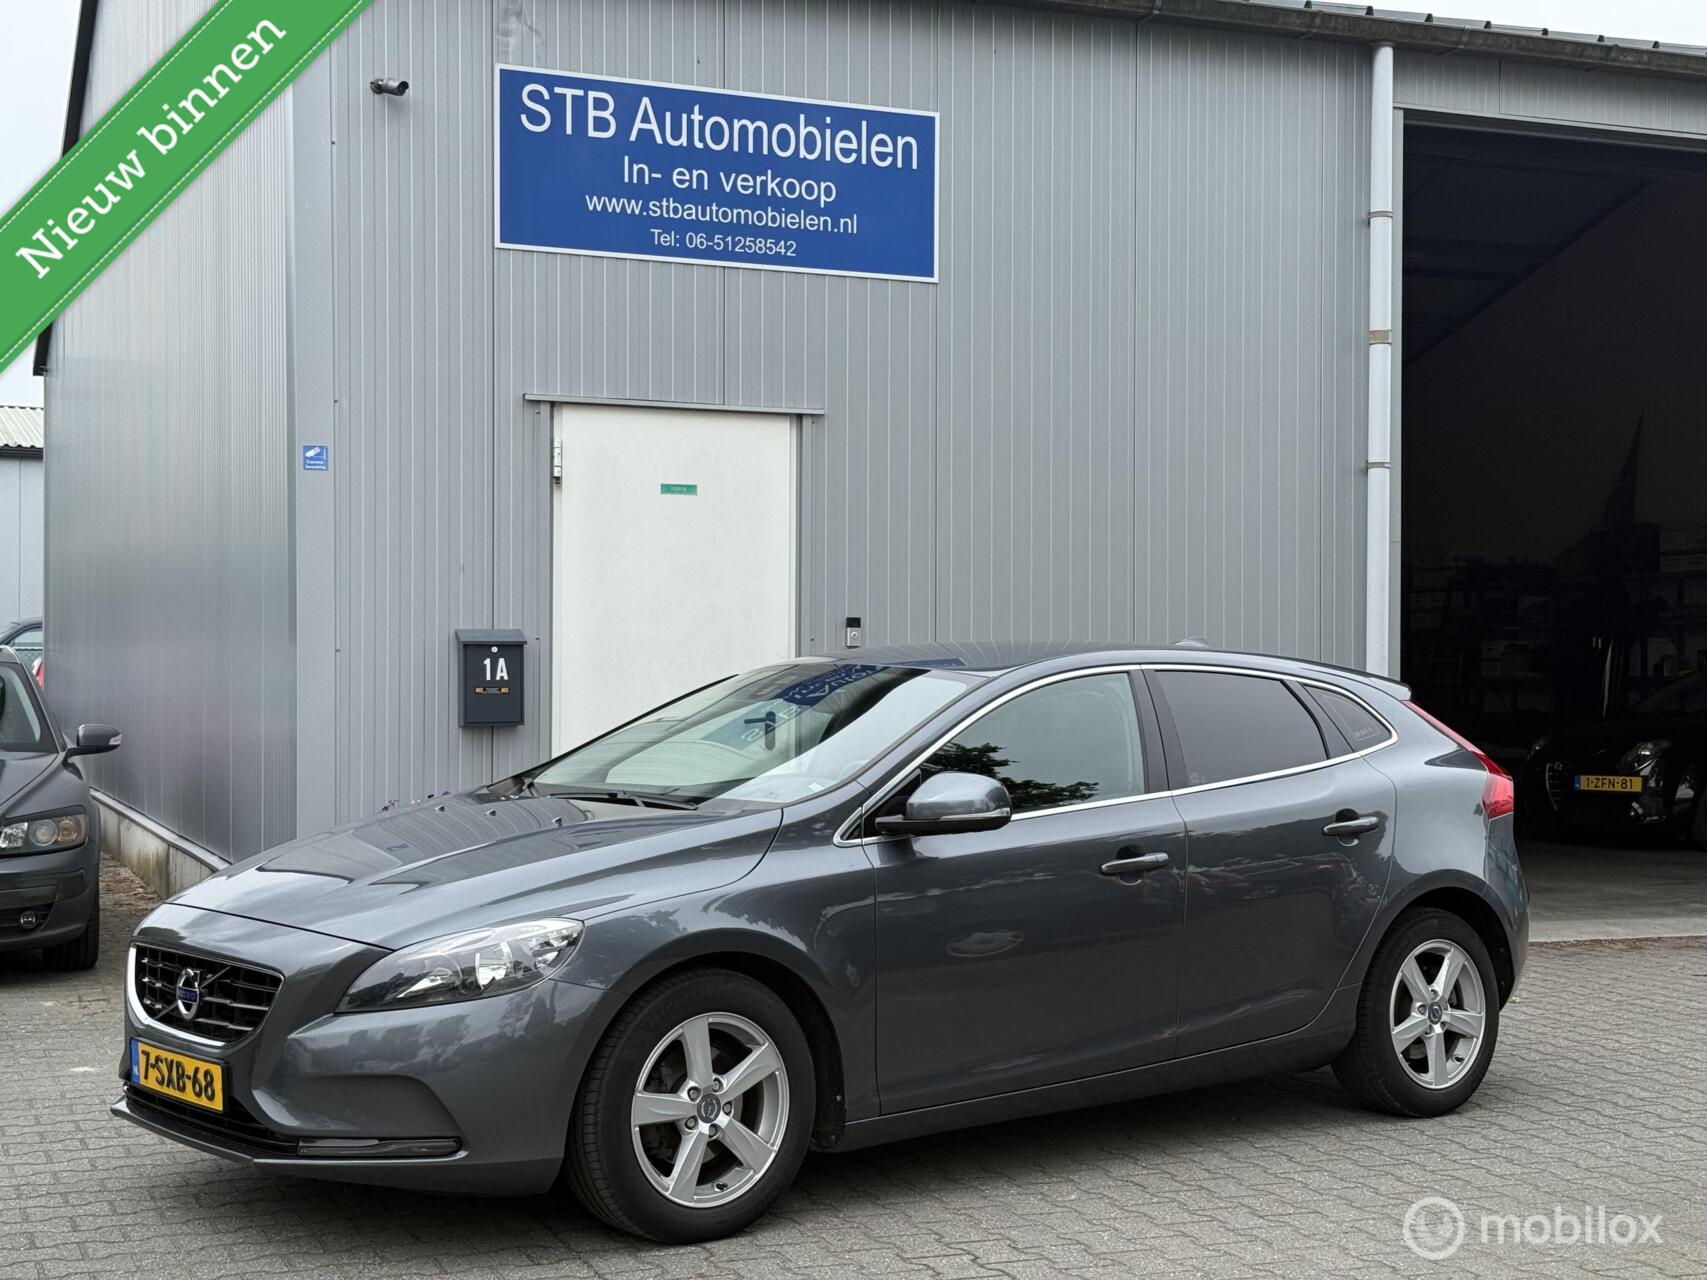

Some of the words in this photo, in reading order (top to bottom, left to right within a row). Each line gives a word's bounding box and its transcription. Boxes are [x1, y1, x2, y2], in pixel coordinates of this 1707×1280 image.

[520, 83, 617, 139] STB
[629, 96, 918, 170] Automobielen
[624, 155, 662, 185] In-
[672, 167, 708, 191] en
[719, 169, 837, 208] verkoop
[585, 195, 857, 234] www.stbautomobielen.nl
[650, 228, 681, 247] Tel:
[686, 232, 797, 257] 06-51258542
[483, 657, 509, 681] 1A
[1586, 777, 1633, 790] 1-ZFN-81
[141, 1049, 216, 1102] 7-SXB-68
